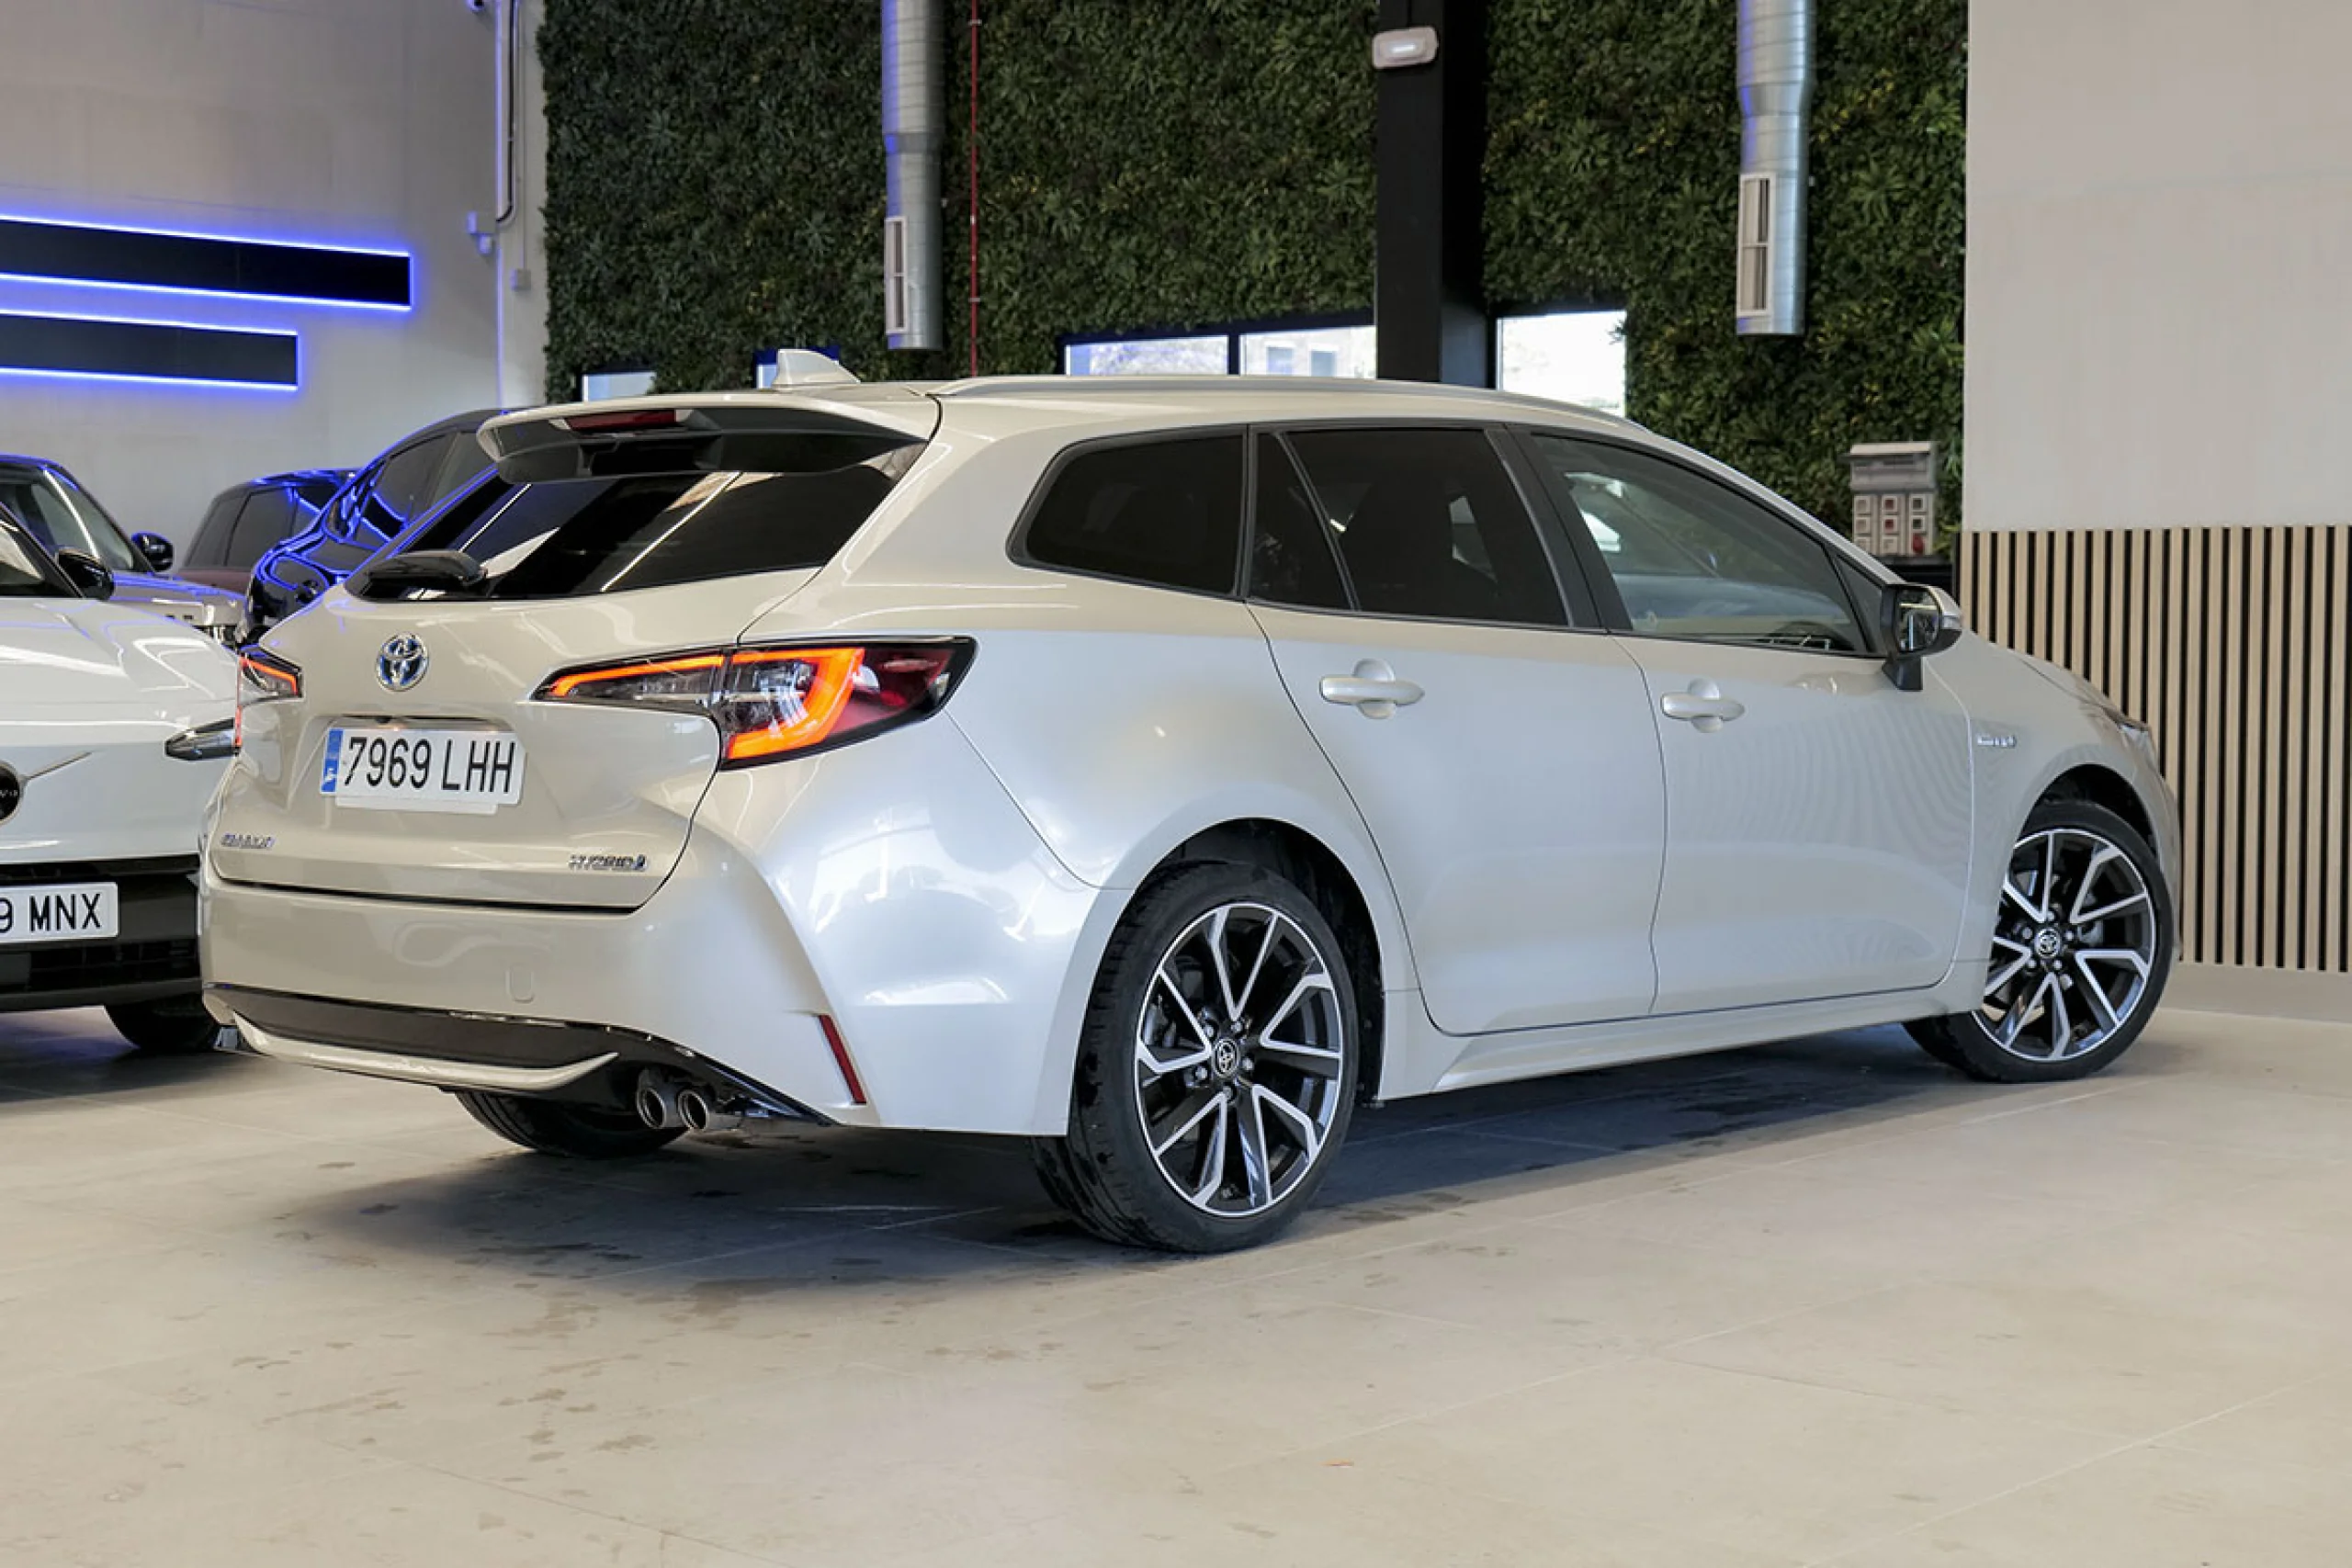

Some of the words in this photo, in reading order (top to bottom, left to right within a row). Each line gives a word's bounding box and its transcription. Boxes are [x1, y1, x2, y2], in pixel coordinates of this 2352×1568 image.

[345, 737, 432, 789] 7969
[441, 739, 516, 794] LHH
[29, 893, 101, 932] MNX
